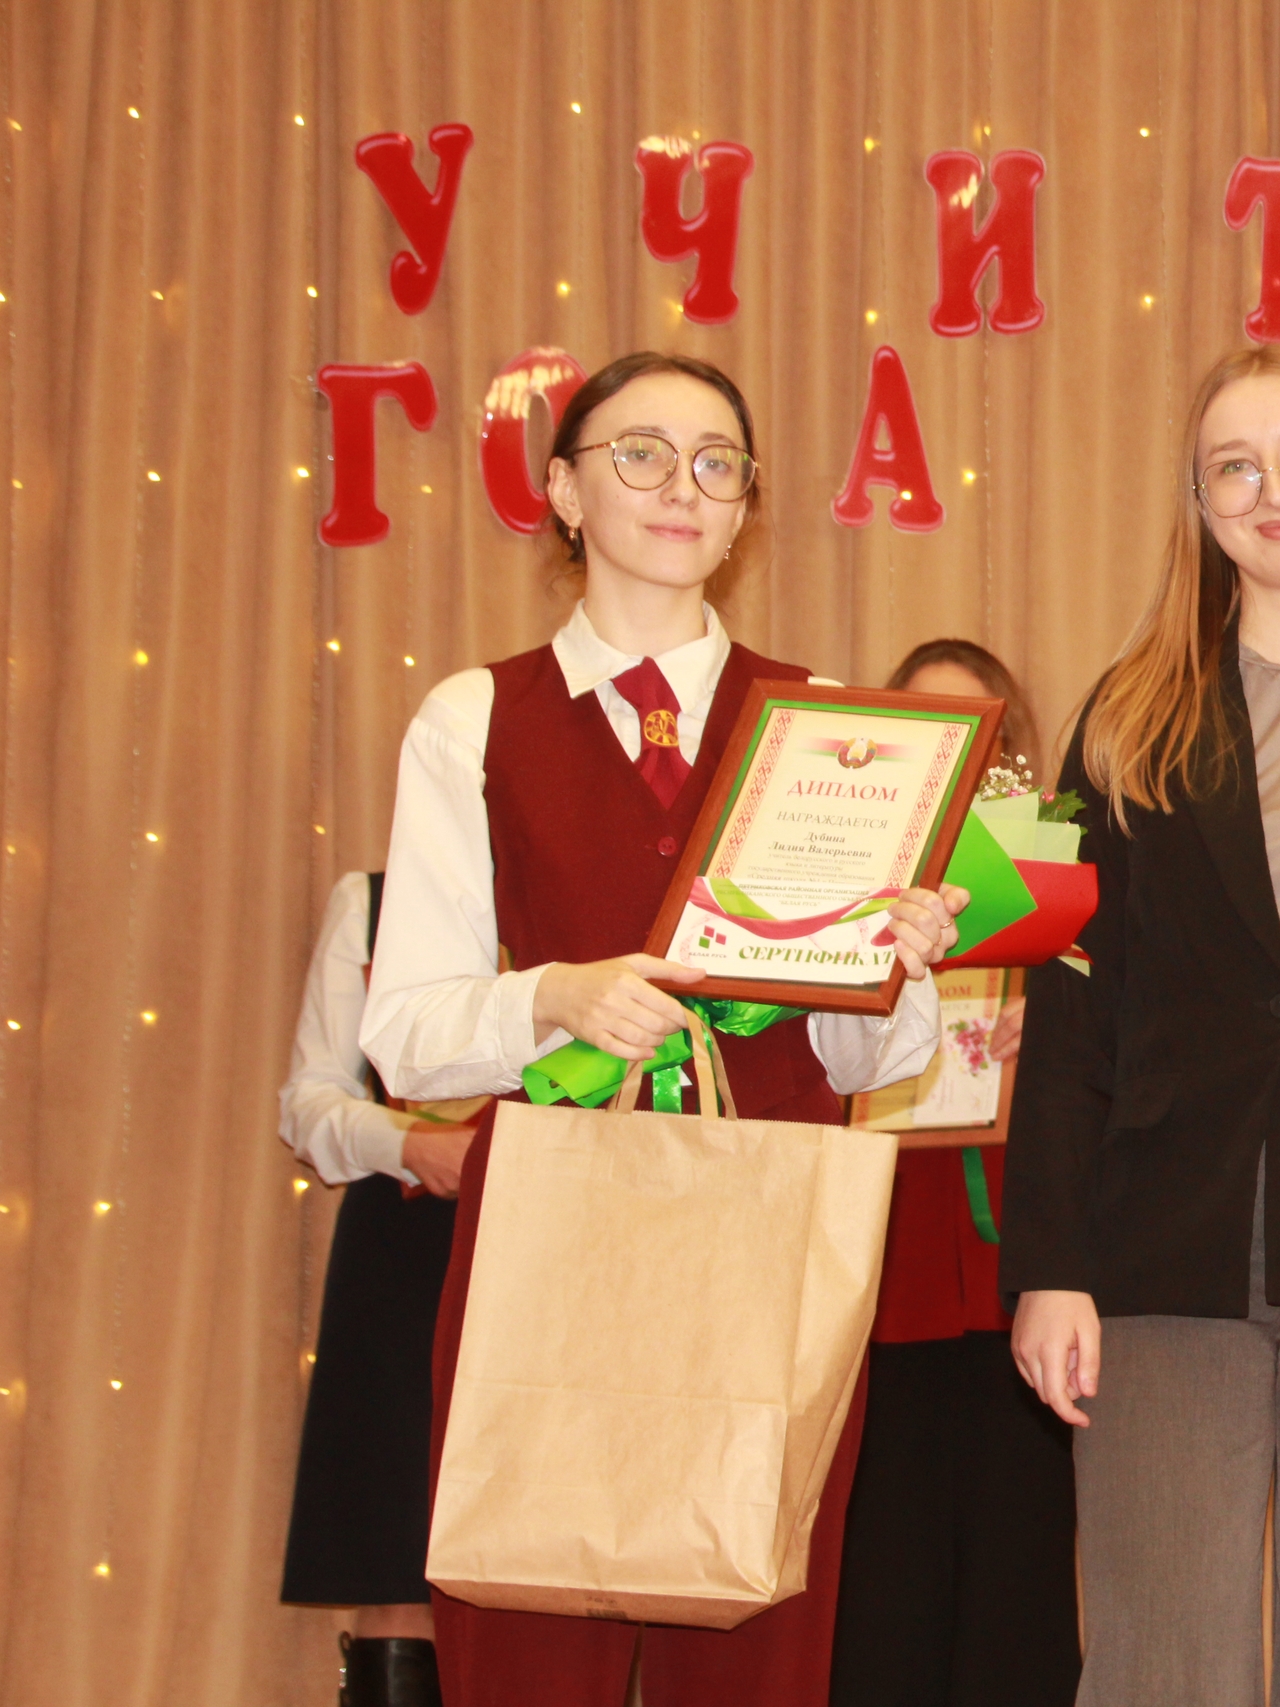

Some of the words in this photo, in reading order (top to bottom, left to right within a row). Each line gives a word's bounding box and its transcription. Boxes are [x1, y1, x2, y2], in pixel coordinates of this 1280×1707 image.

[317, 345, 945, 547] ГОА
[787, 779, 900, 802] ДИПЛОМ
[777, 811, 888, 829] НАГРАЖДАЕТСЯ
[804, 831, 846, 844] Дубина
[768, 841, 805, 853] Лидия
[808, 844, 872, 859] Валерьевна
[739, 945, 897, 966] СЕРТИФИКАТ
